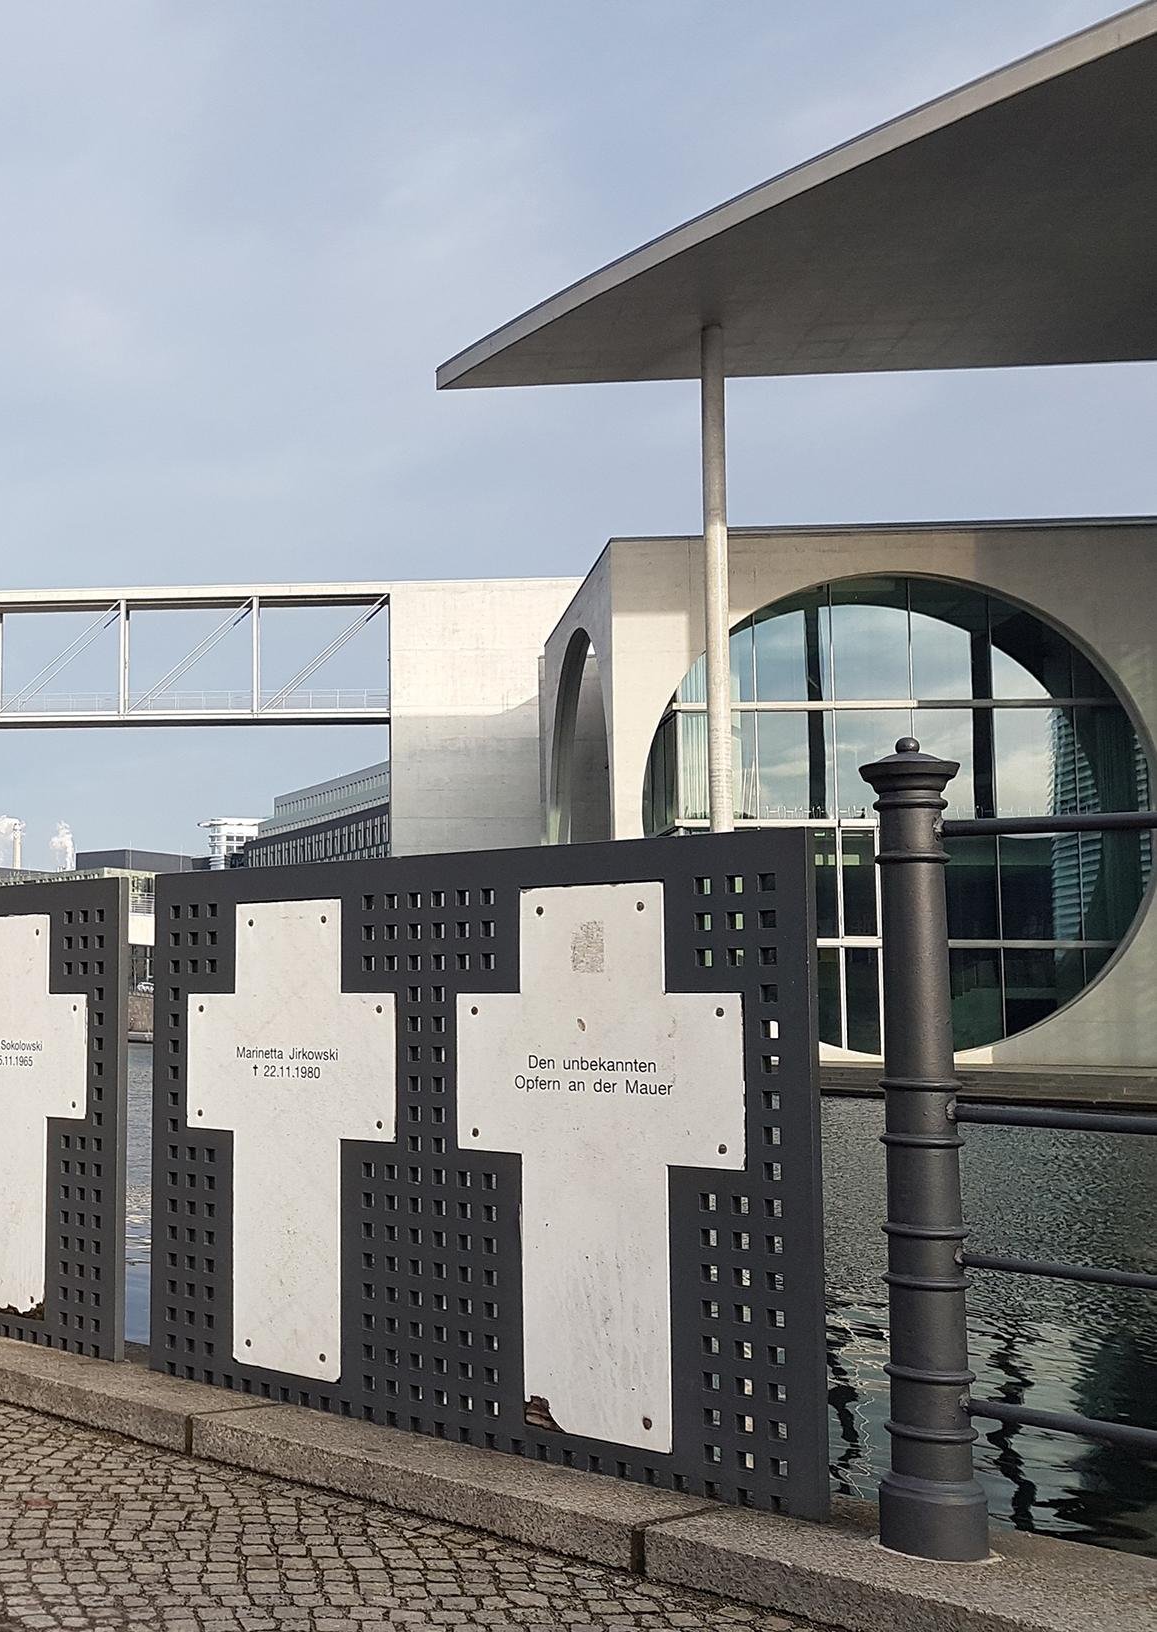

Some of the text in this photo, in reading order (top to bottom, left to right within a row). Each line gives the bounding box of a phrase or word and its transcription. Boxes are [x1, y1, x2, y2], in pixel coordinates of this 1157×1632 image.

[0, 1039, 43, 1052] Sokolowski
[236, 1046, 339, 1061] Marinetta Jirkowski
[528, 1055, 657, 1073] Den unbekannten
[263, 1065, 321, 1079] 22.11.1980
[514, 1075, 673, 1096] Opfern an der Mauer
